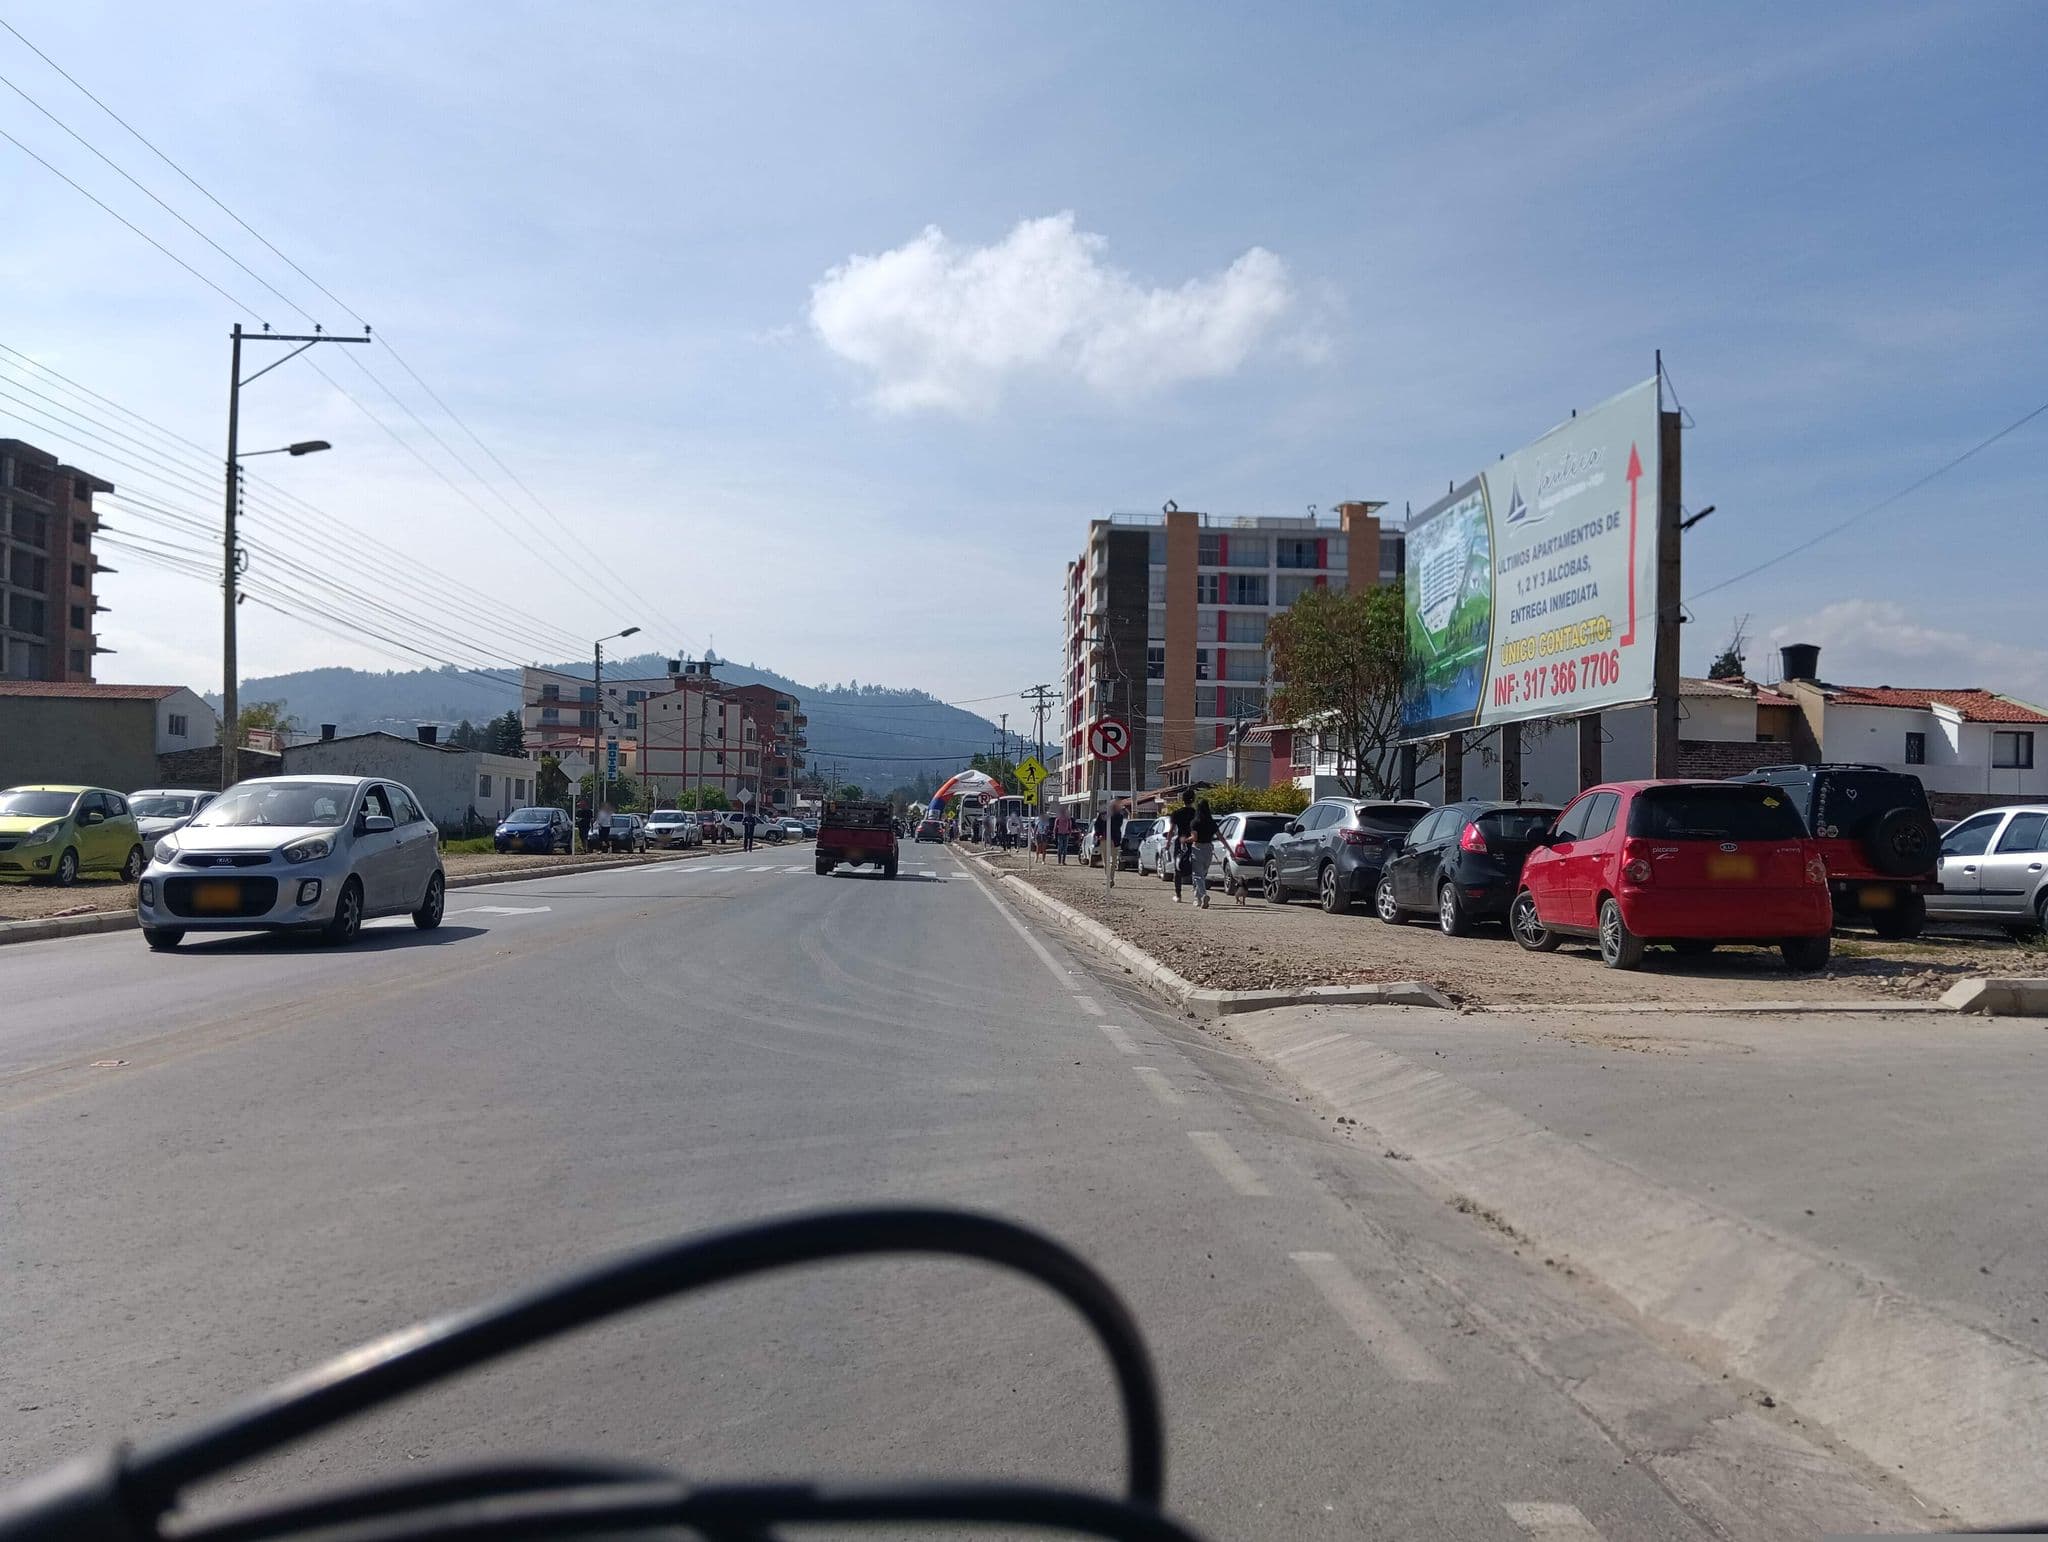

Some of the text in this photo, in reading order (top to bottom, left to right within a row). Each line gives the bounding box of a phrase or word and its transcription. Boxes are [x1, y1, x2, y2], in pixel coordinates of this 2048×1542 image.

[1532, 518, 1604, 562] APARTAMENTOS
[1606, 511, 1620, 530] DE
[1517, 555, 1591, 597] 1, 2 Y 3 ALCOBAS,
[1511, 582, 1598, 624] ENTREGA INMEDIATA
[1500, 615, 1612, 667] ÚNICO CONTACTO:
[1494, 649, 1619, 707] INF: 317 366 7706
[1102, 726, 1121, 753] P
